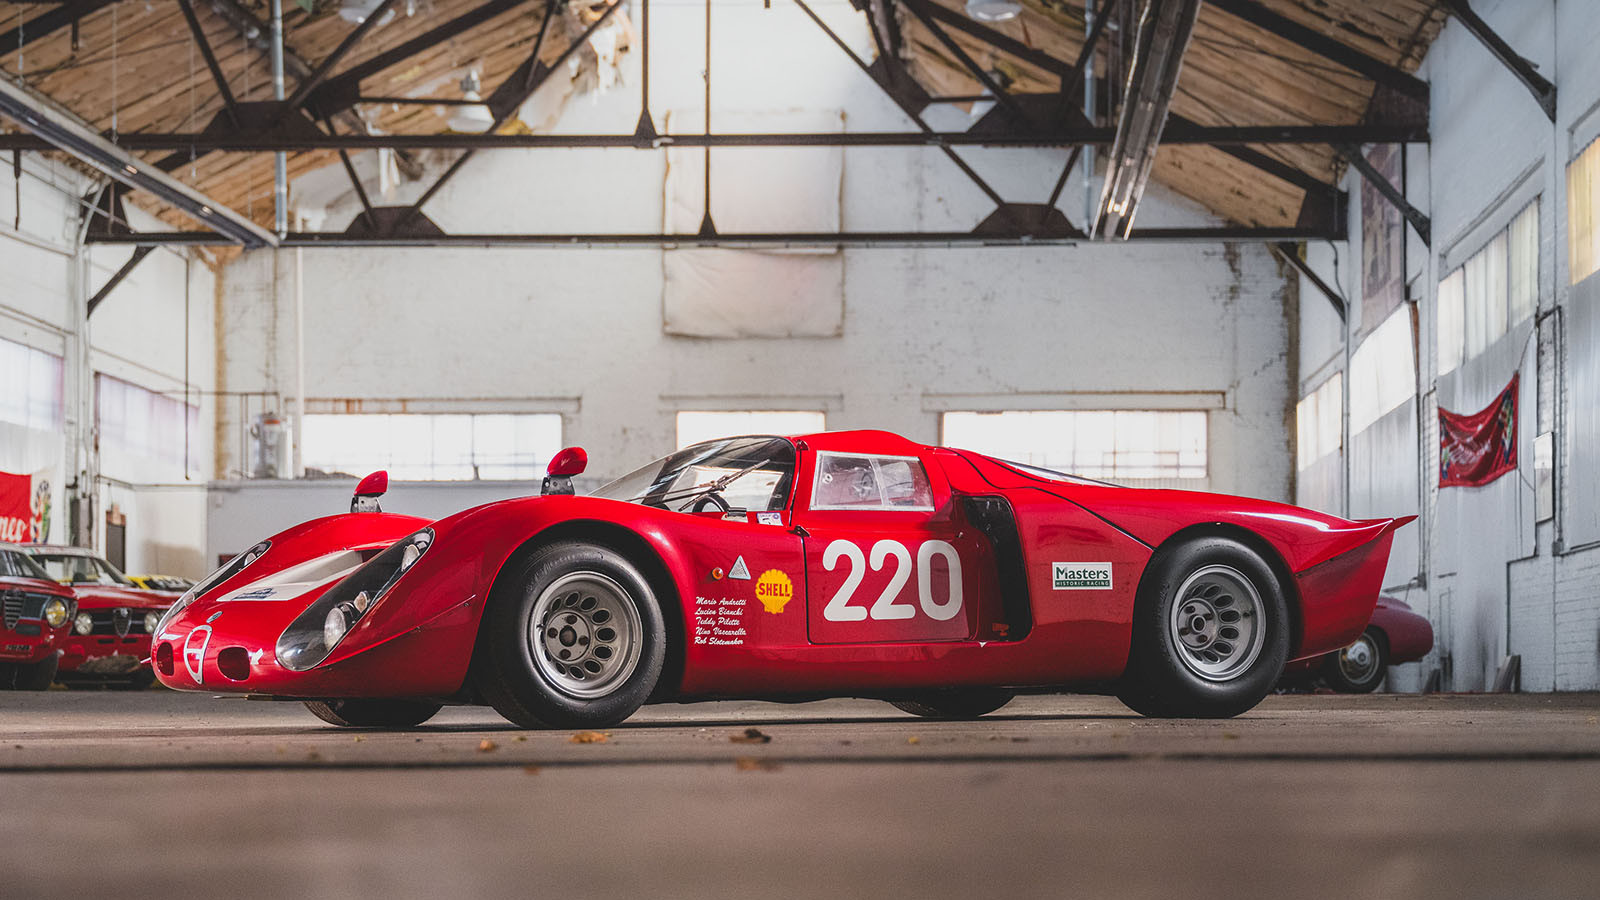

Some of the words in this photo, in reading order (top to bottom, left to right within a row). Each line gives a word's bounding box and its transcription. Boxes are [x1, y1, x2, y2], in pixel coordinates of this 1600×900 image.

[1056, 567, 1109, 579] Masters
[822, 539, 963, 621] 220
[759, 583, 790, 597] SHELL
[695, 596, 717, 605] Mario
[718, 597, 747, 606] Andretti
[694, 607, 717, 615] Lucien
[718, 607, 744, 616] Bianchi
[695, 616, 716, 627] Teddy
[695, 626, 711, 635] Nino
[694, 636, 708, 645] Rob
